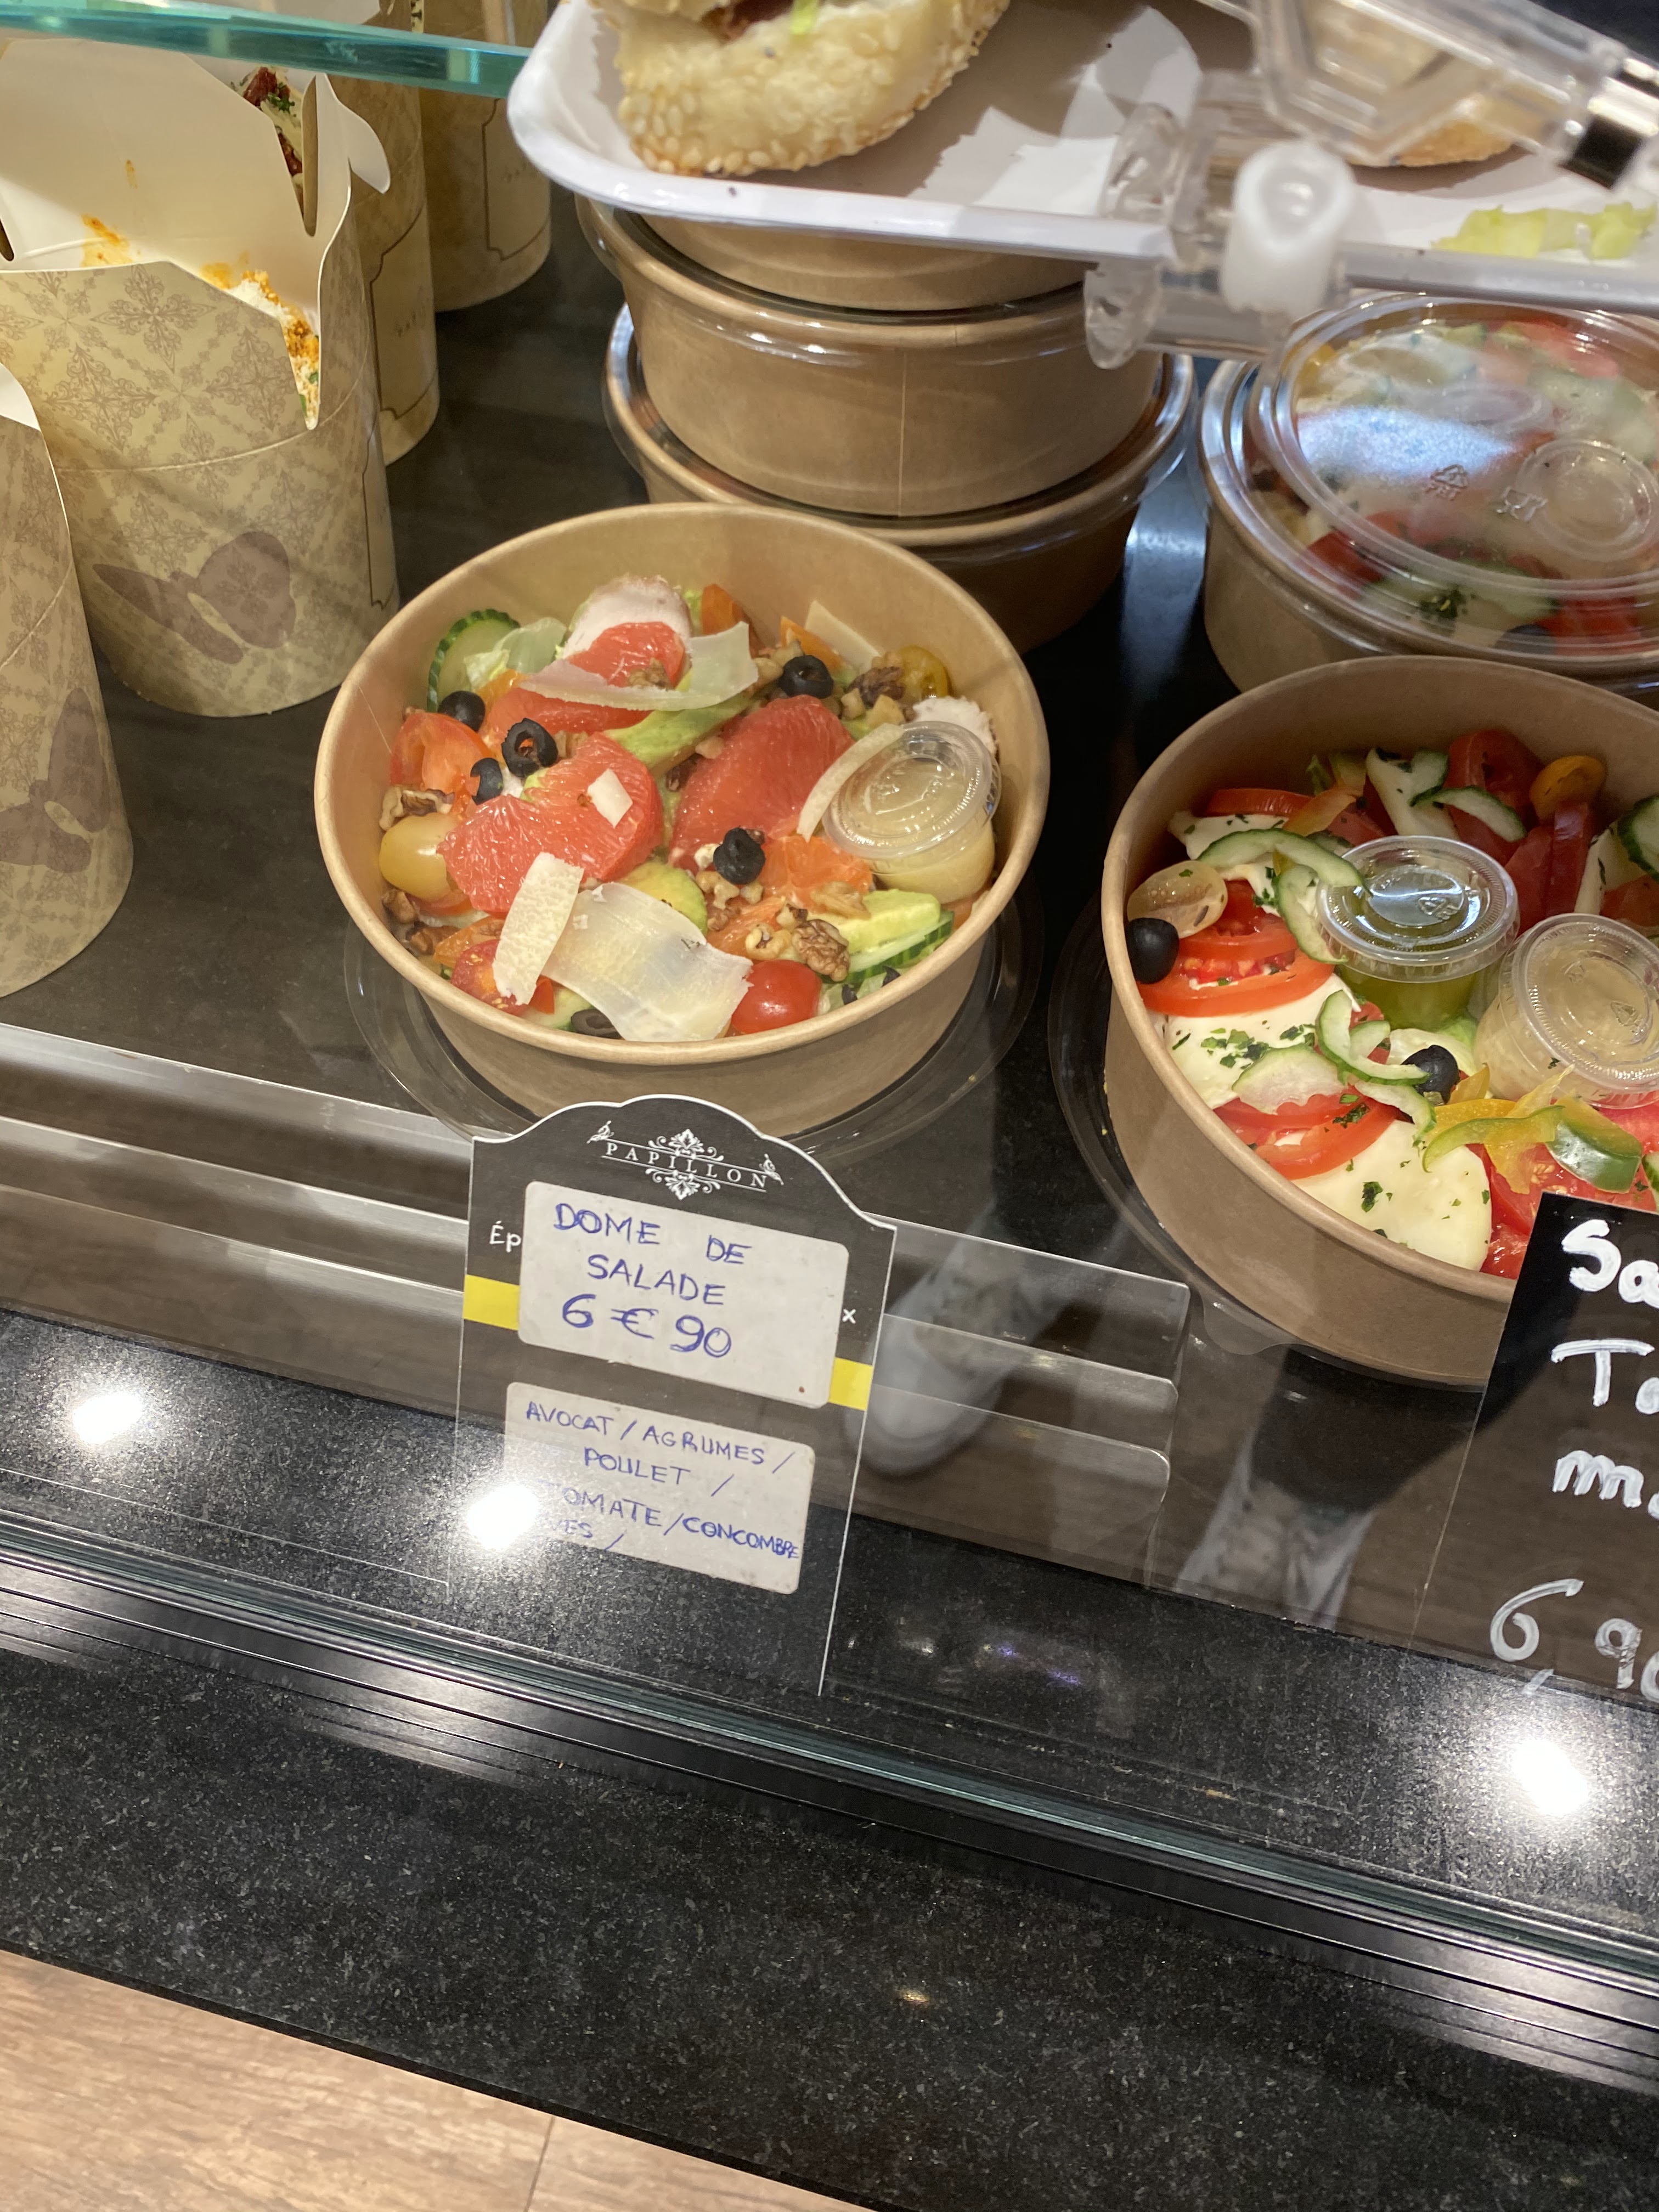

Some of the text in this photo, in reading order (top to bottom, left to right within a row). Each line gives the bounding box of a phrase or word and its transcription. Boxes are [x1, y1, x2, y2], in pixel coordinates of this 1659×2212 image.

[605, 1143, 768, 1188] PAPILLON
[553, 1203, 752, 1265] DOME DE
[587, 1254, 726, 1305] SALADE
[584, 1447, 692, 1485] POULET
